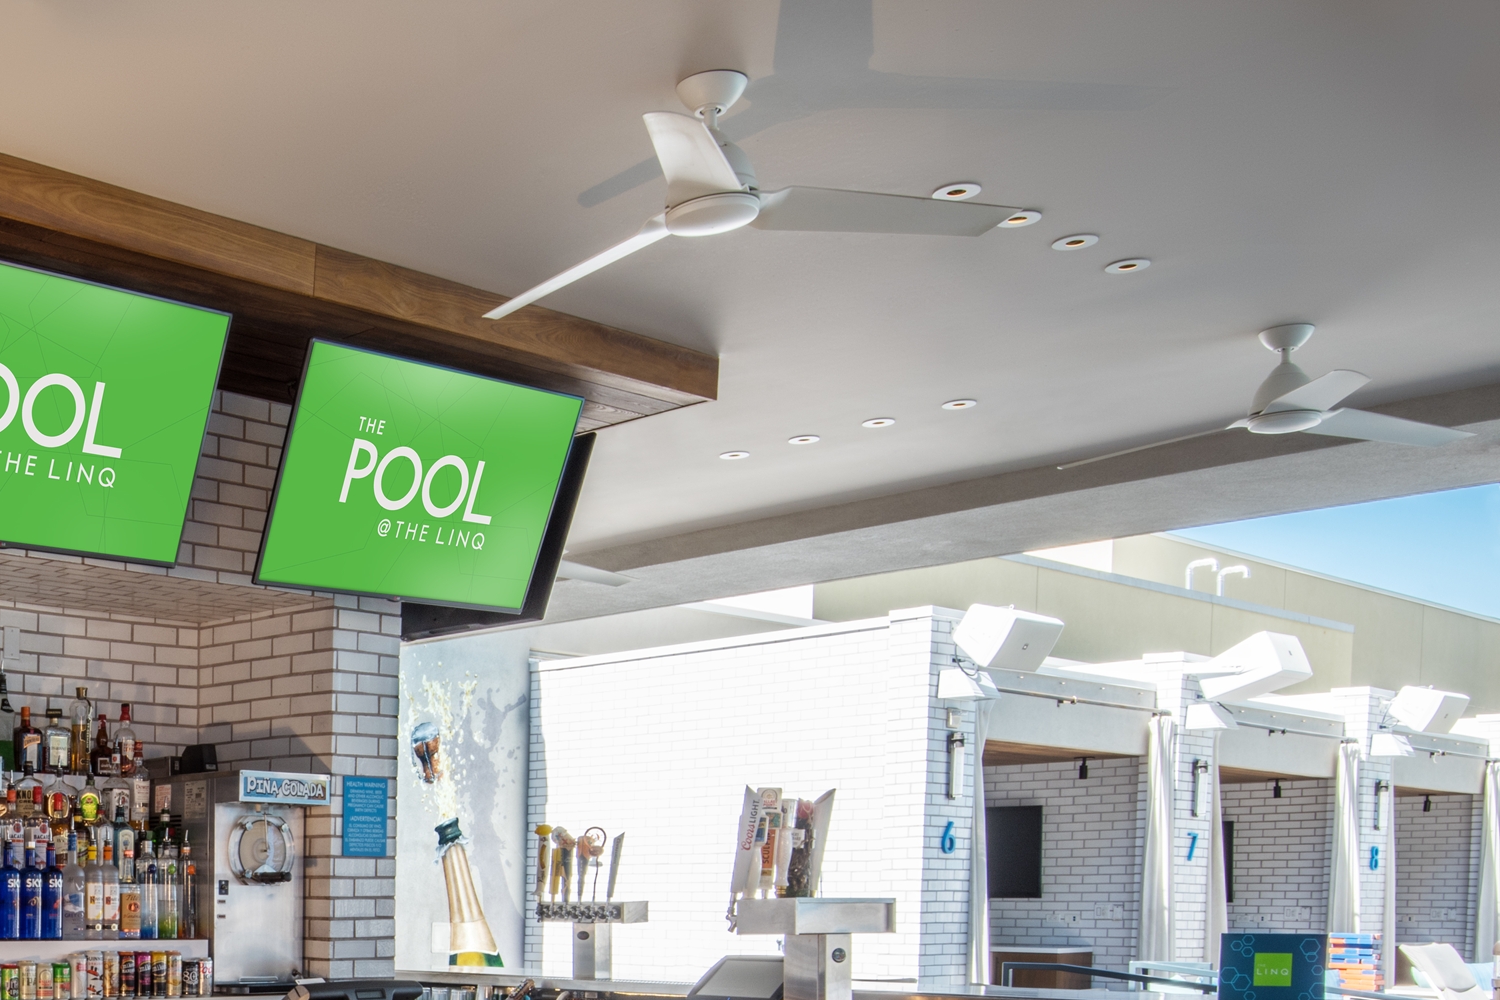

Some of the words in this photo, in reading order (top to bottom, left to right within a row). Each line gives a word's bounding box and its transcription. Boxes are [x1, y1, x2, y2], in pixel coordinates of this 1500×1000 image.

[358, 415, 386, 436] THE
[47, 458, 116, 488] LINQ
[338, 437, 493, 526] POOL
[435, 526, 485, 551] LINQ
[16, 789, 33, 800] KNO
[246, 775, 279, 795] PIÑA
[281, 779, 324, 798] COLADA
[741, 824, 755, 851] Coors
[749, 799, 760, 824] LIGHT
[941, 821, 956, 854] 6
[1187, 832, 1198, 861] 7
[1369, 846, 1379, 871] 8
[1256, 968, 1289, 976] LINQ
